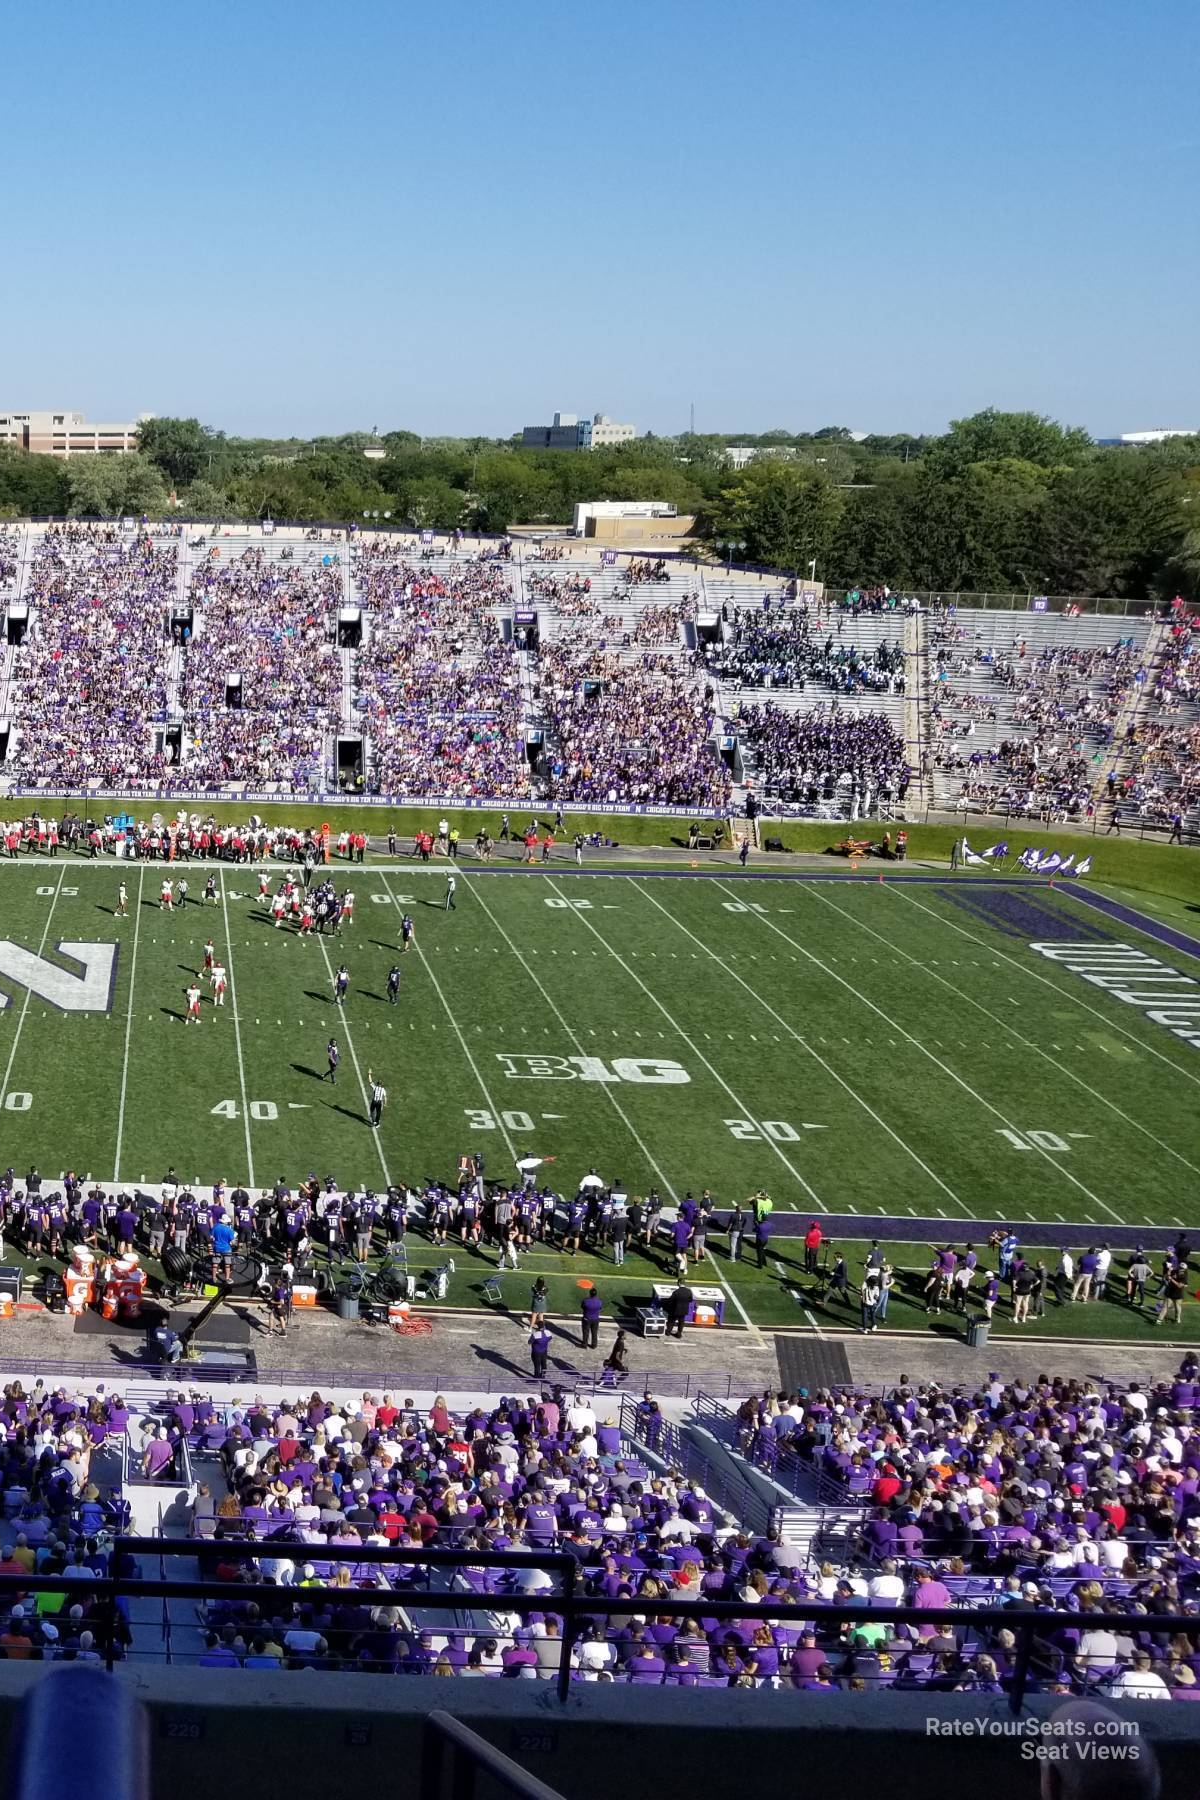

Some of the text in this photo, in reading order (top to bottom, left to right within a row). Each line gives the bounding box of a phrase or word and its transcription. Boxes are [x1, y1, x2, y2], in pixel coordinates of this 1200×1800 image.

[36, 886, 78, 895] 50
[371, 894, 417, 904] 30
[544, 898, 593, 908] 20
[721, 902, 769, 912] 10
[211, 1100, 278, 1119] 40
[464, 1110, 535, 1131] 30
[722, 1120, 800, 1141] 20
[995, 1130, 1071, 1151] 10
